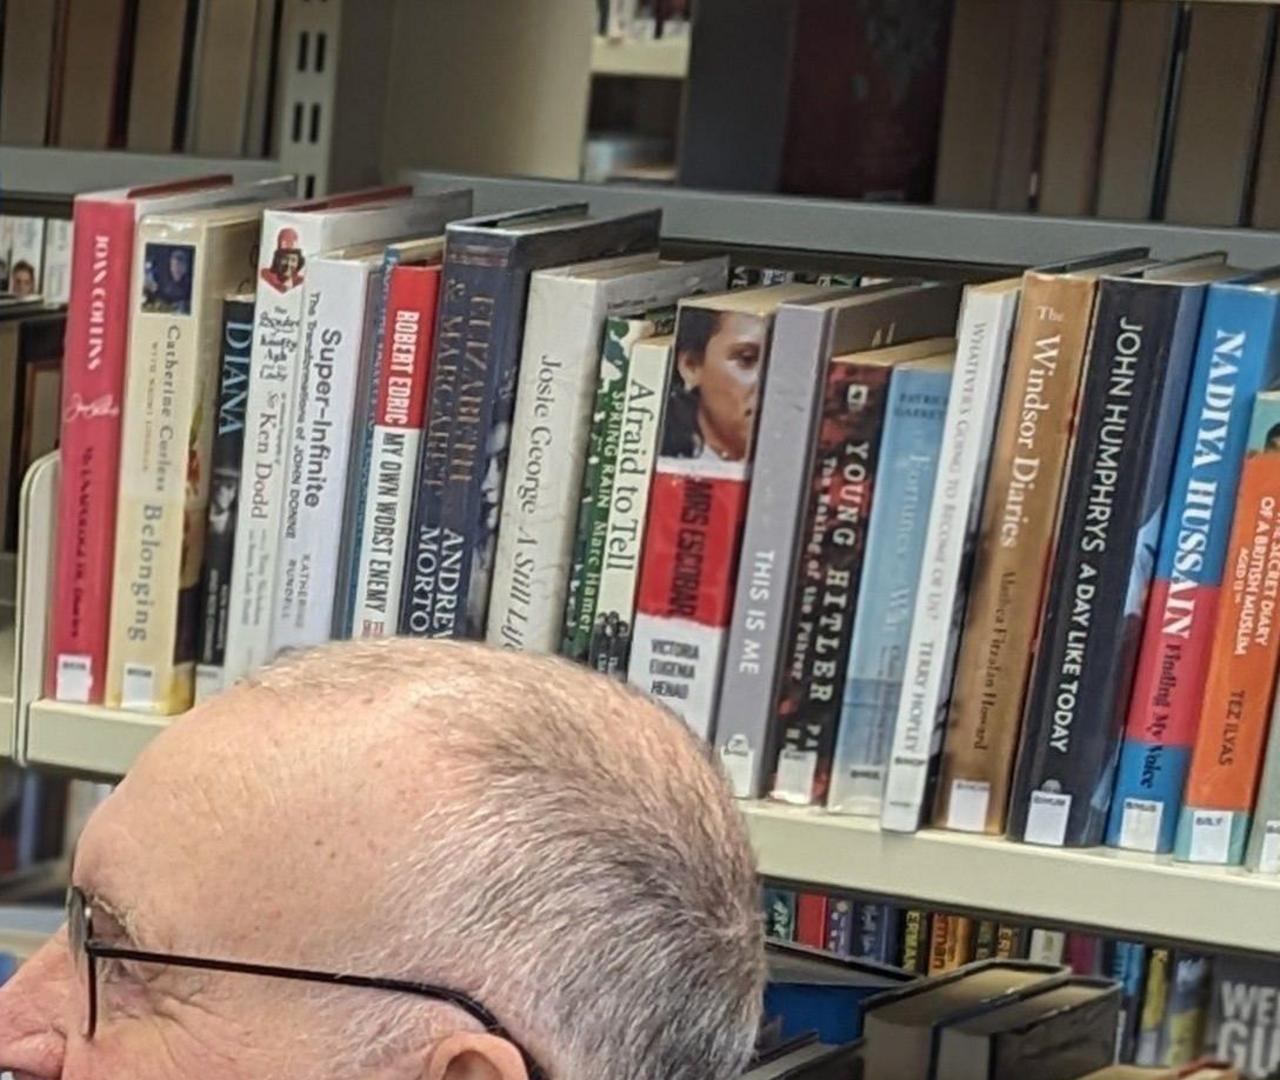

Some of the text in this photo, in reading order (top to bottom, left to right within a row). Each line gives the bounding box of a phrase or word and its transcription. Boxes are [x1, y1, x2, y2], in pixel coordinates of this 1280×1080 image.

[87, 235, 110, 370] JOAN COLLINS
[390, 310, 420, 375] ROBERT
[218, 321, 254, 436] DIANA
[285, 292, 321, 540] The of JOHN DONNE
[305, 327, 343, 507] Super-Infinite
[384, 376, 412, 425] EDRIC
[423, 315, 463, 487] MARGARET
[449, 296, 495, 483] ELIZABETH
[1000, 305, 1064, 548] The Windsor Diaries
[127, 324, 182, 641] Catherine Curless Belonging
[251, 411, 277, 519] Ken Dodd
[378, 460, 402, 501] OWN
[382, 432, 405, 458] MY
[509, 354, 563, 604] Josie George A Still
[606, 379, 655, 571] Afraid to Tell
[1161, 329, 1247, 640] NADIYA HUSSAIN
[371, 502, 398, 555] WORST
[579, 391, 625, 633] SPRING RAIN Marc Hamer
[668, 476, 715, 618] MRS ESCOBAR
[801, 456, 838, 614] The of the
[896, 453, 932, 560] Fortunes
[1048, 315, 1144, 753] JOHN HUMPHRYS A DAY LIKE TODAY
[364, 558, 392, 613] ENEMY
[738, 550, 775, 675] THIS IS ME
[808, 440, 870, 702] YOUNG HITLER
[1234, 496, 1275, 656] OF A BRITISH MUSLIM
[1235, 547, 1250, 579] AGED
[649, 659, 696, 681] EUGENIA
[650, 638, 700, 660] VICTORIA
[1151, 642, 1181, 709] Finding
[1255, 600, 1276, 646] DIARY
[650, 680, 690, 700] HENAO
[905, 640, 934, 752] TERRY HOPLEY
[973, 692, 998, 751] Howard
[1145, 714, 1171, 741] My
[1218, 688, 1245, 768] TEZ ILYAS
[1139, 743, 1164, 789] Voice
